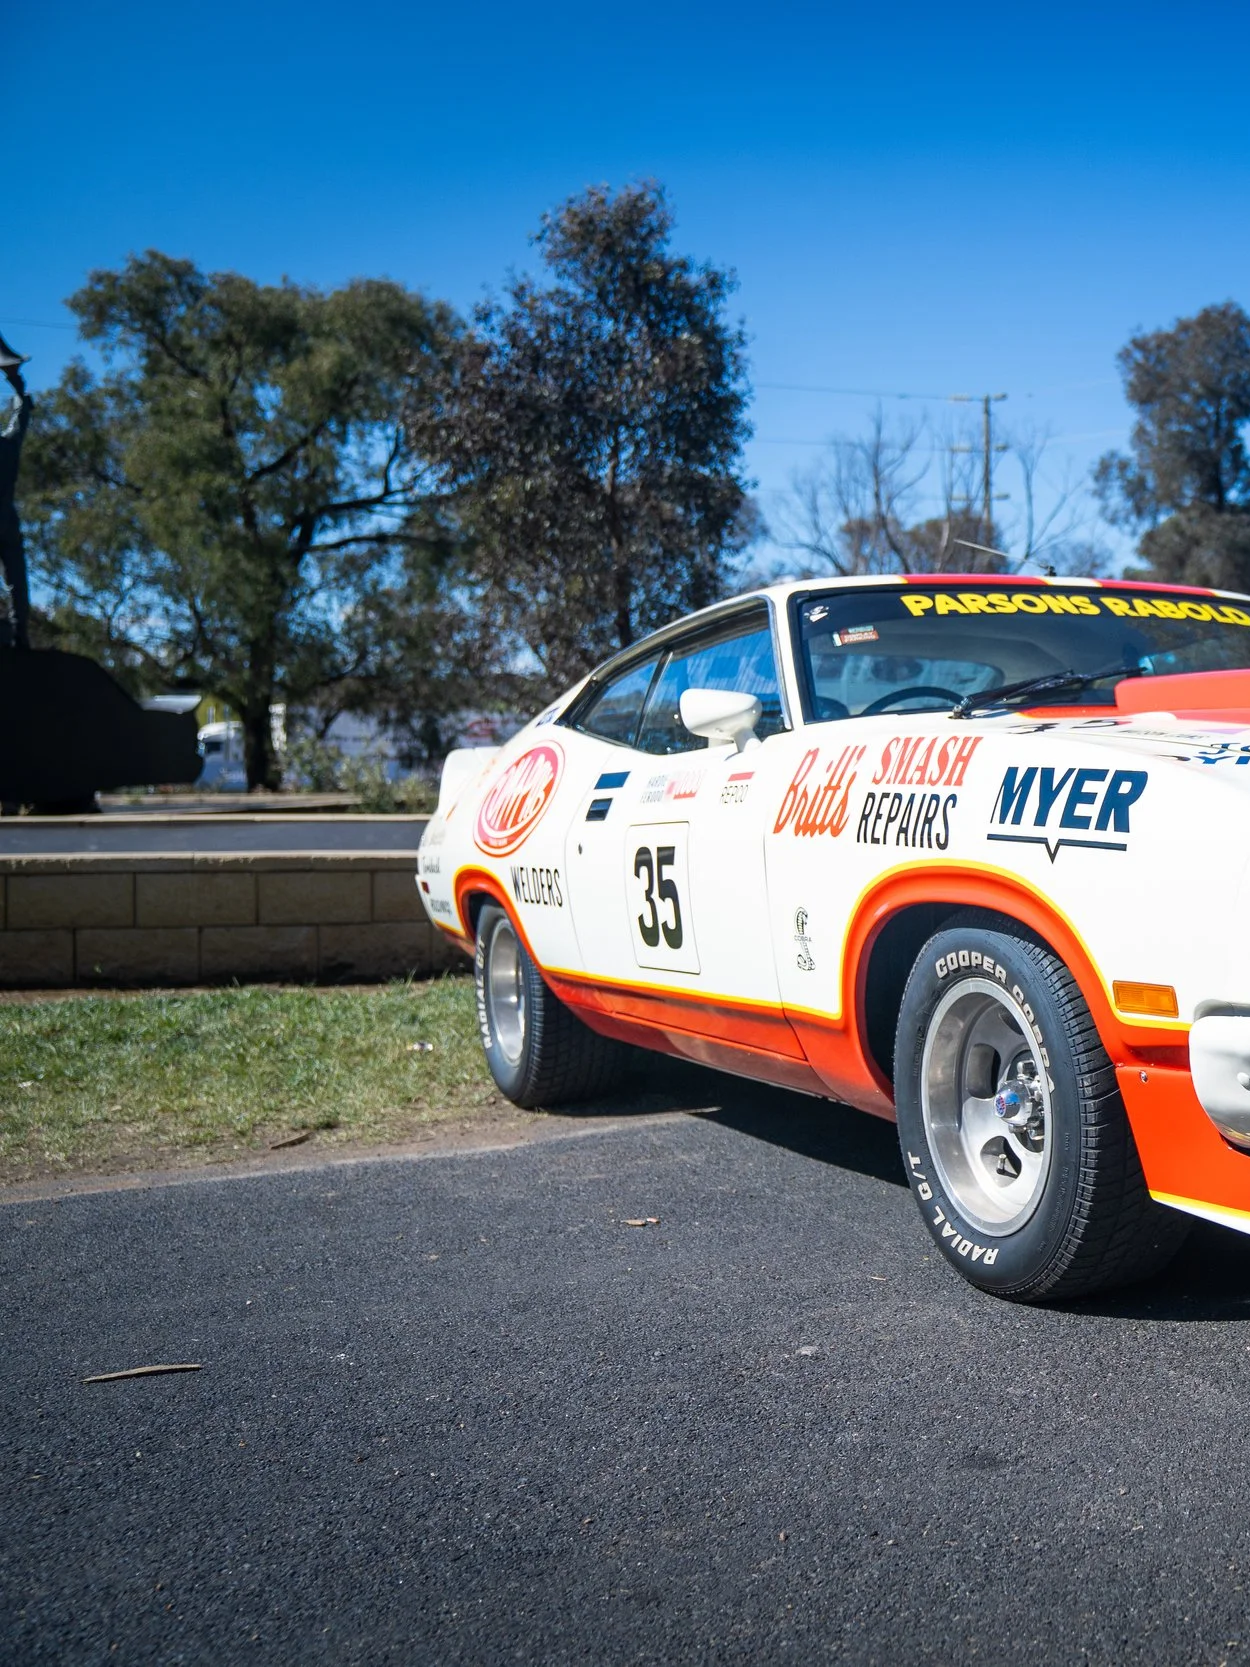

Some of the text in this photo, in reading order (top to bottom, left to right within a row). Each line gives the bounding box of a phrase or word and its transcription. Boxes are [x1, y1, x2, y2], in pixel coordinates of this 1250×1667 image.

[900, 593, 1101, 616] PARSONS
[872, 736, 984, 786] SMASH
[857, 792, 958, 850] REPAIRS
[991, 766, 1149, 833] MYER
[510, 866, 563, 907] WELDERS
[634, 846, 683, 949] 35
[935, 950, 1007, 985] COOPER
[908, 1151, 999, 1266] RADIAL G/T
